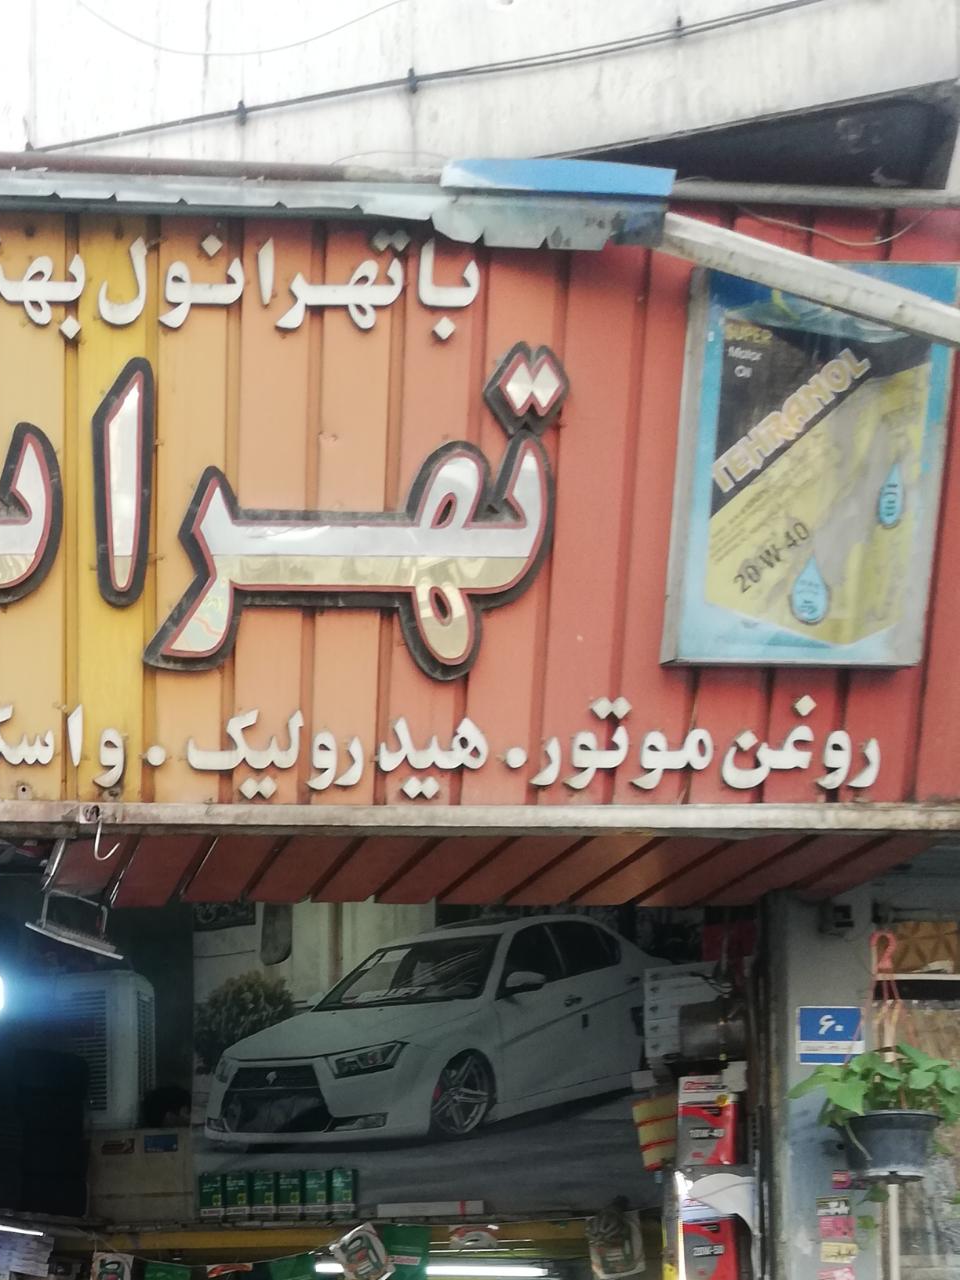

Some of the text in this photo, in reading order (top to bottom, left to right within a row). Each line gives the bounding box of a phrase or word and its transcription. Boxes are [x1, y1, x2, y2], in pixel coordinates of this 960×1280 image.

[98, 228, 407, 332] تهرانول
[417, 236, 481, 341] با
[711, 347, 872, 494] TEHRANOL
[720, 694, 881, 791] روغن
